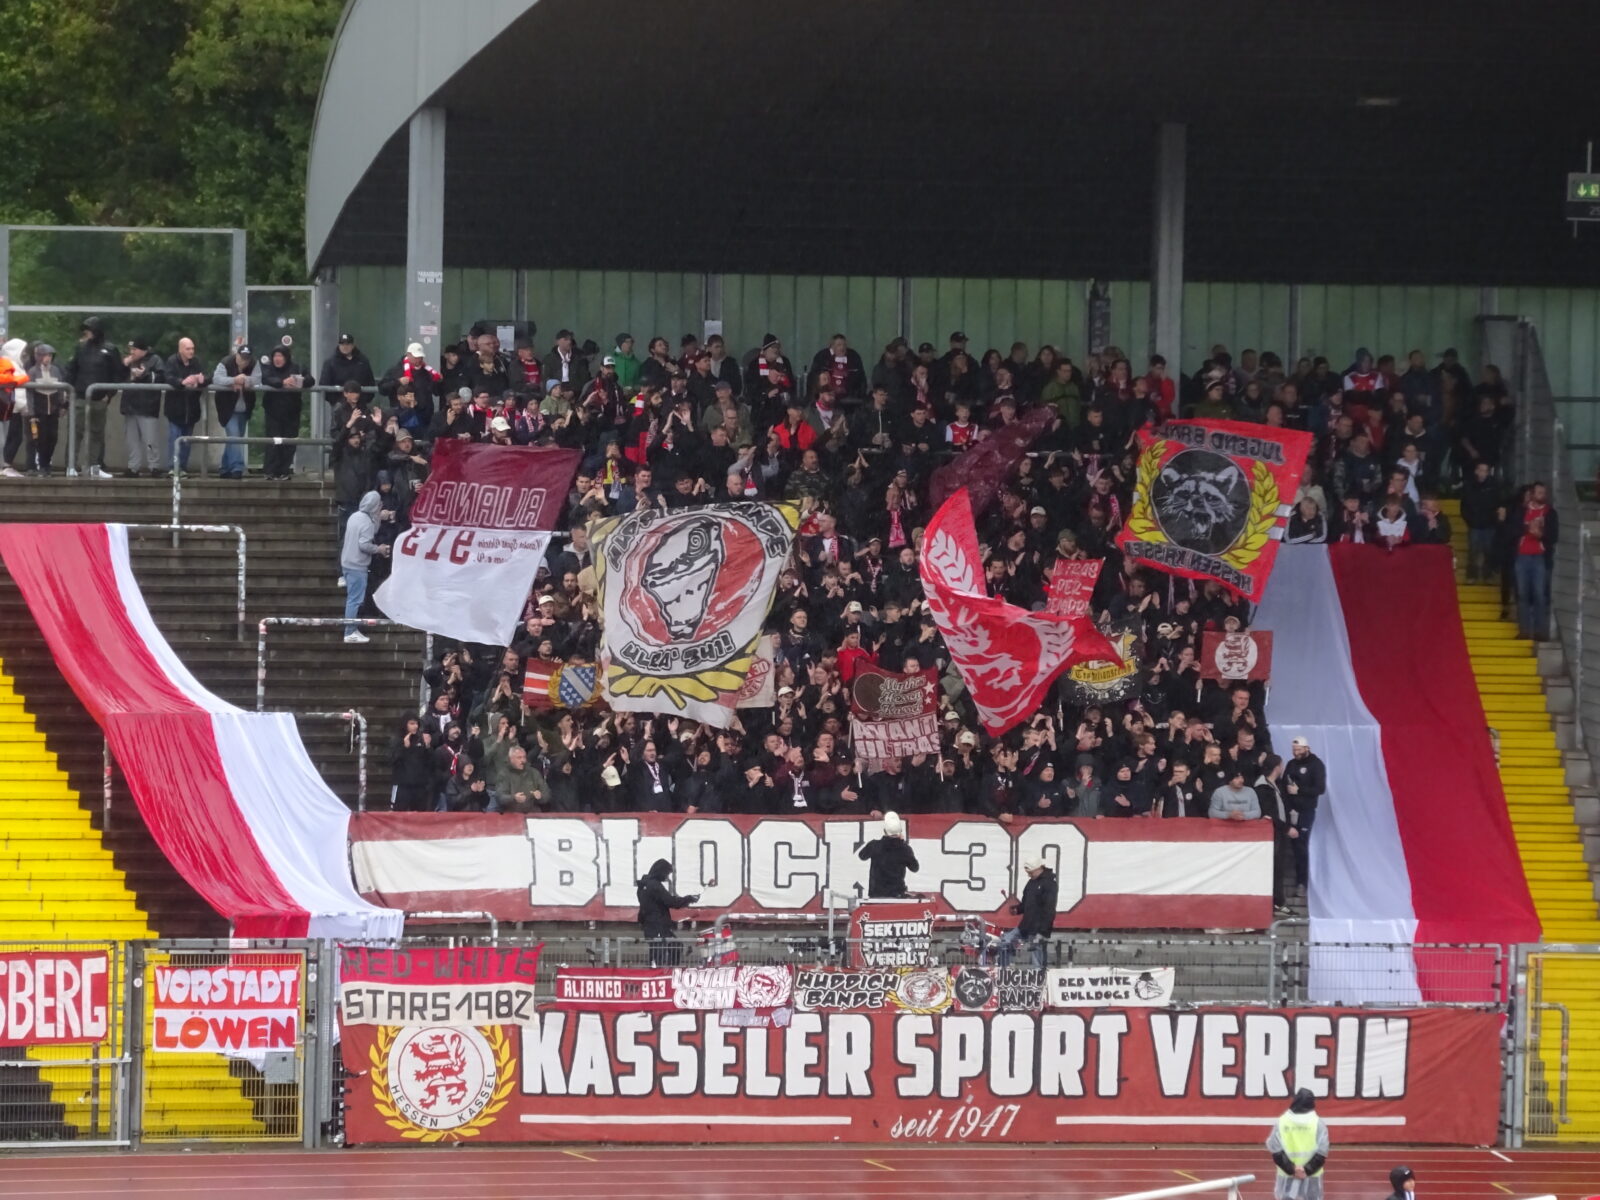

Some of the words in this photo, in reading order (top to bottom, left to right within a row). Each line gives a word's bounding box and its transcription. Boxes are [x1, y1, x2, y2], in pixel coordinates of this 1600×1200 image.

[1046, 597, 1089, 615] SEMPR
[751, 660, 769, 676] 30
[853, 713, 938, 740] AVANTI
[855, 733, 940, 758] ULTRAS
[526, 817, 907, 910] BLOCK
[941, 820, 1088, 914] 30
[863, 921, 929, 937] SEKTION
[155, 967, 297, 1005] VORSTADT
[564, 980, 622, 998] ALIANCO
[641, 981, 666, 998] 913
[672, 966, 737, 989] LOYAL
[797, 972, 900, 991] HUDDICH
[996, 969, 1047, 989] JUGEND
[1058, 977, 1086, 988] RED
[1088, 976, 1132, 987] WHITE
[0, 957, 107, 1040] BERG
[673, 987, 738, 1010] CREW
[804, 989, 885, 1009] BANDE
[1000, 987, 1042, 1009] BANDE
[1061, 990, 1131, 1001] BULLDOGS
[155, 1011, 296, 1050] LÖWEN
[520, 1011, 873, 1098] KASSELER
[897, 1013, 1129, 1099] SPORT
[1150, 1014, 1411, 1099] VEREIN
[391, 1085, 438, 1128] HESSEN
[457, 1071, 496, 1123] KASSEL
[890, 1108, 942, 1139] seit
[944, 1104, 1021, 1139] 1947
